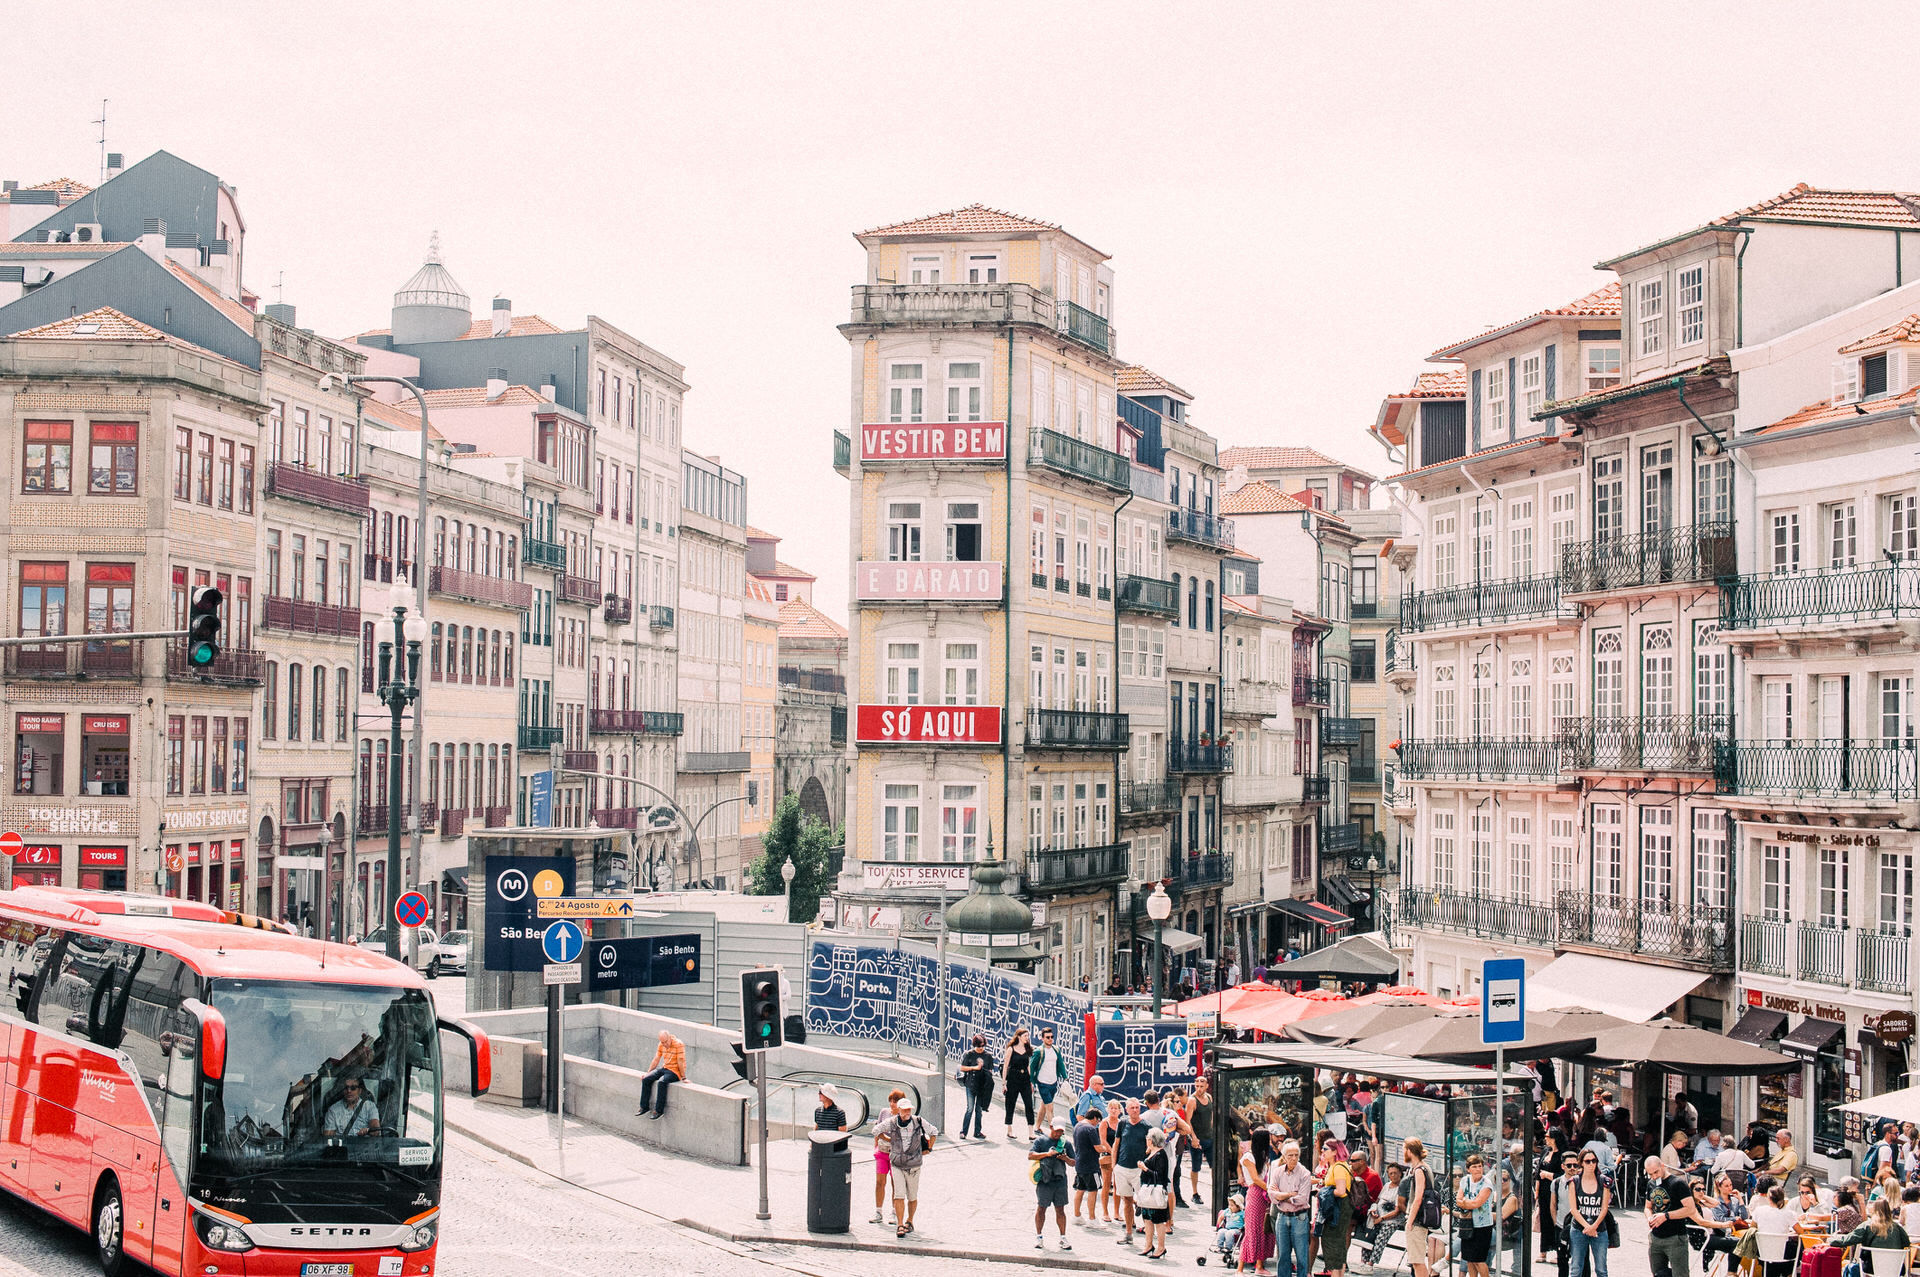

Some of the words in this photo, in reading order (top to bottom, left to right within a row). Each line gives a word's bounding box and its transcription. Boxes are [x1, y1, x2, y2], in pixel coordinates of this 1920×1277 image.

[863, 429, 945, 454] VESTIR
[954, 428, 1001, 453] BEM
[869, 568, 880, 592] E
[896, 568, 990, 593] BARATO
[881, 707, 912, 737] SÓ
[921, 711, 975, 737] AQUI
[29, 808, 101, 821] TOURIST
[165, 810, 207, 828] TOURIST
[209, 808, 248, 827] SERVICE
[50, 820, 119, 833] SERVICE
[1777, 831, 1821, 844] Restaurante
[1831, 834, 1852, 846] Salão
[1853, 834, 1864, 846] de
[1865, 835, 1880, 848] Chá
[90, 852, 117, 860] TOURS
[918, 868, 965, 879] SERVICE
[554, 901, 565, 909] 24
[567, 901, 600, 910] Agosto
[500, 927, 522, 939] São
[659, 946, 673, 955] São
[673, 945, 695, 955] Bento
[597, 970, 618, 979] metro
[859, 979, 892, 995] Porto.
[951, 1000, 971, 1017] Porto.
[1765, 995, 1800, 1014] SABORES
[1816, 1003, 1846, 1022] Invicta
[81, 1068, 117, 1093] Nunes
[1577, 1195, 1601, 1206] YOGA
[290, 1227, 371, 1236] SETRA
[391, 1262, 402, 1271] TP
